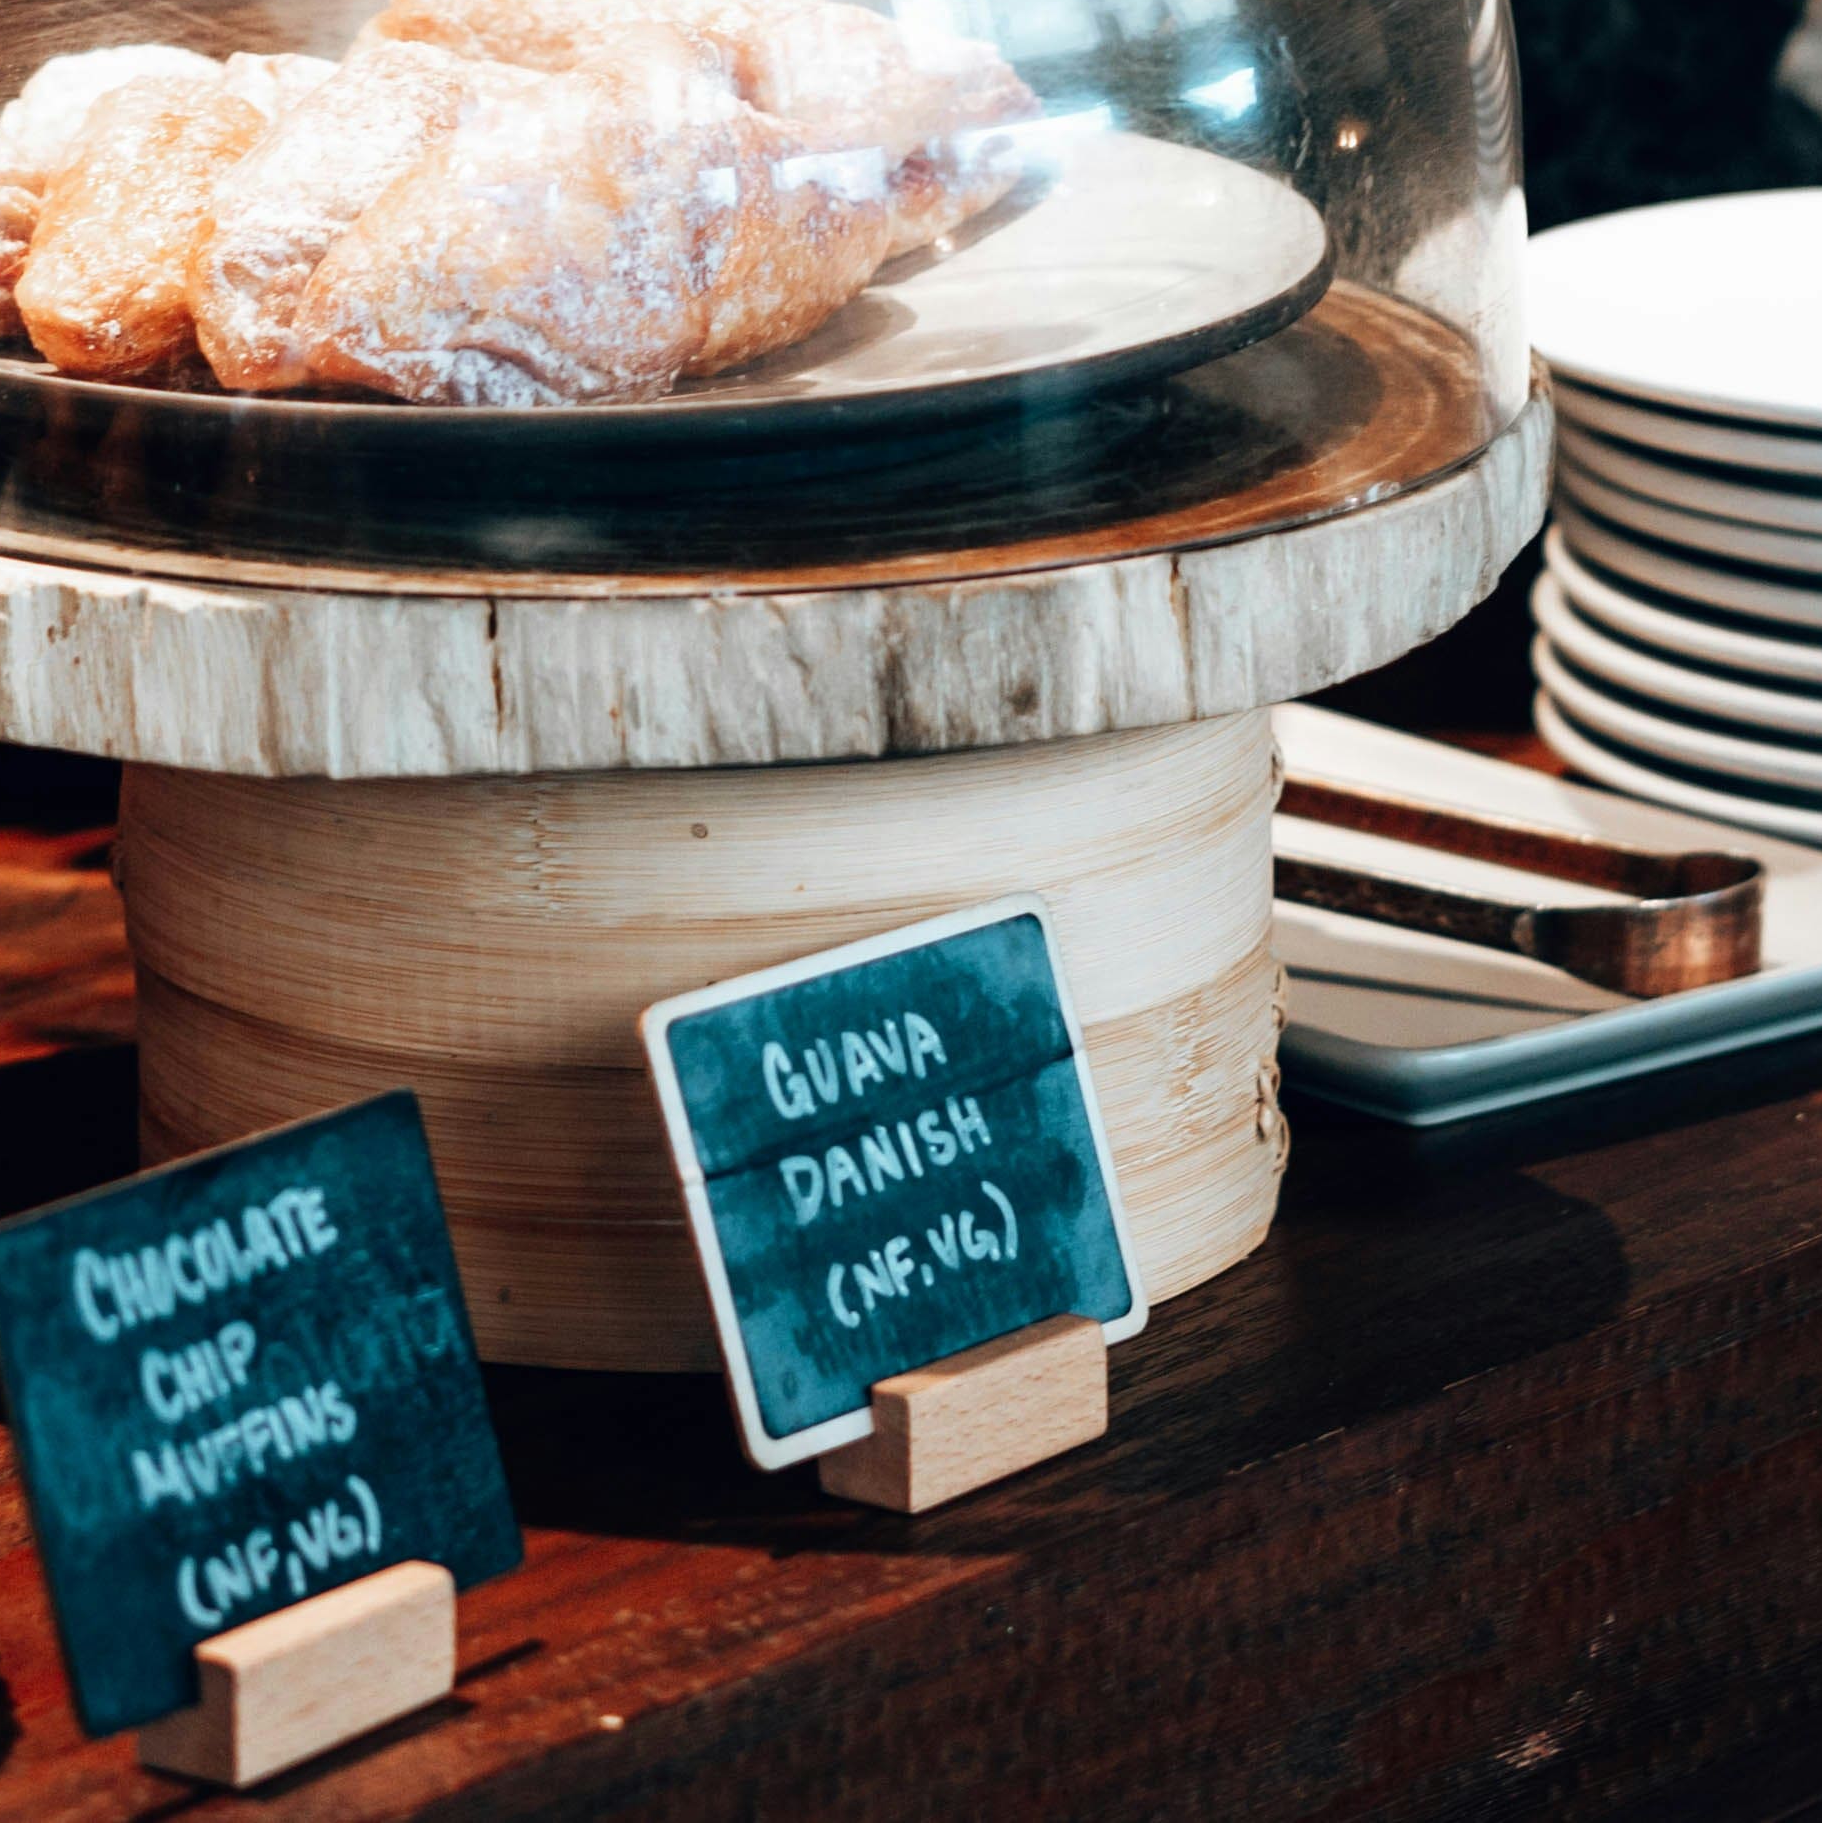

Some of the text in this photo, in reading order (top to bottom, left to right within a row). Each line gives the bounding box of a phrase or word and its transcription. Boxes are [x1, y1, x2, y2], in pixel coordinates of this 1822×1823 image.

[762, 1012, 947, 1119] GUAVA
[780, 1096, 992, 1226] DANISH
[73, 1185, 338, 1341] CHOCOLATE
[140, 1320, 257, 1424] CHIP
[130, 1380, 358, 1510] MUFFINS
